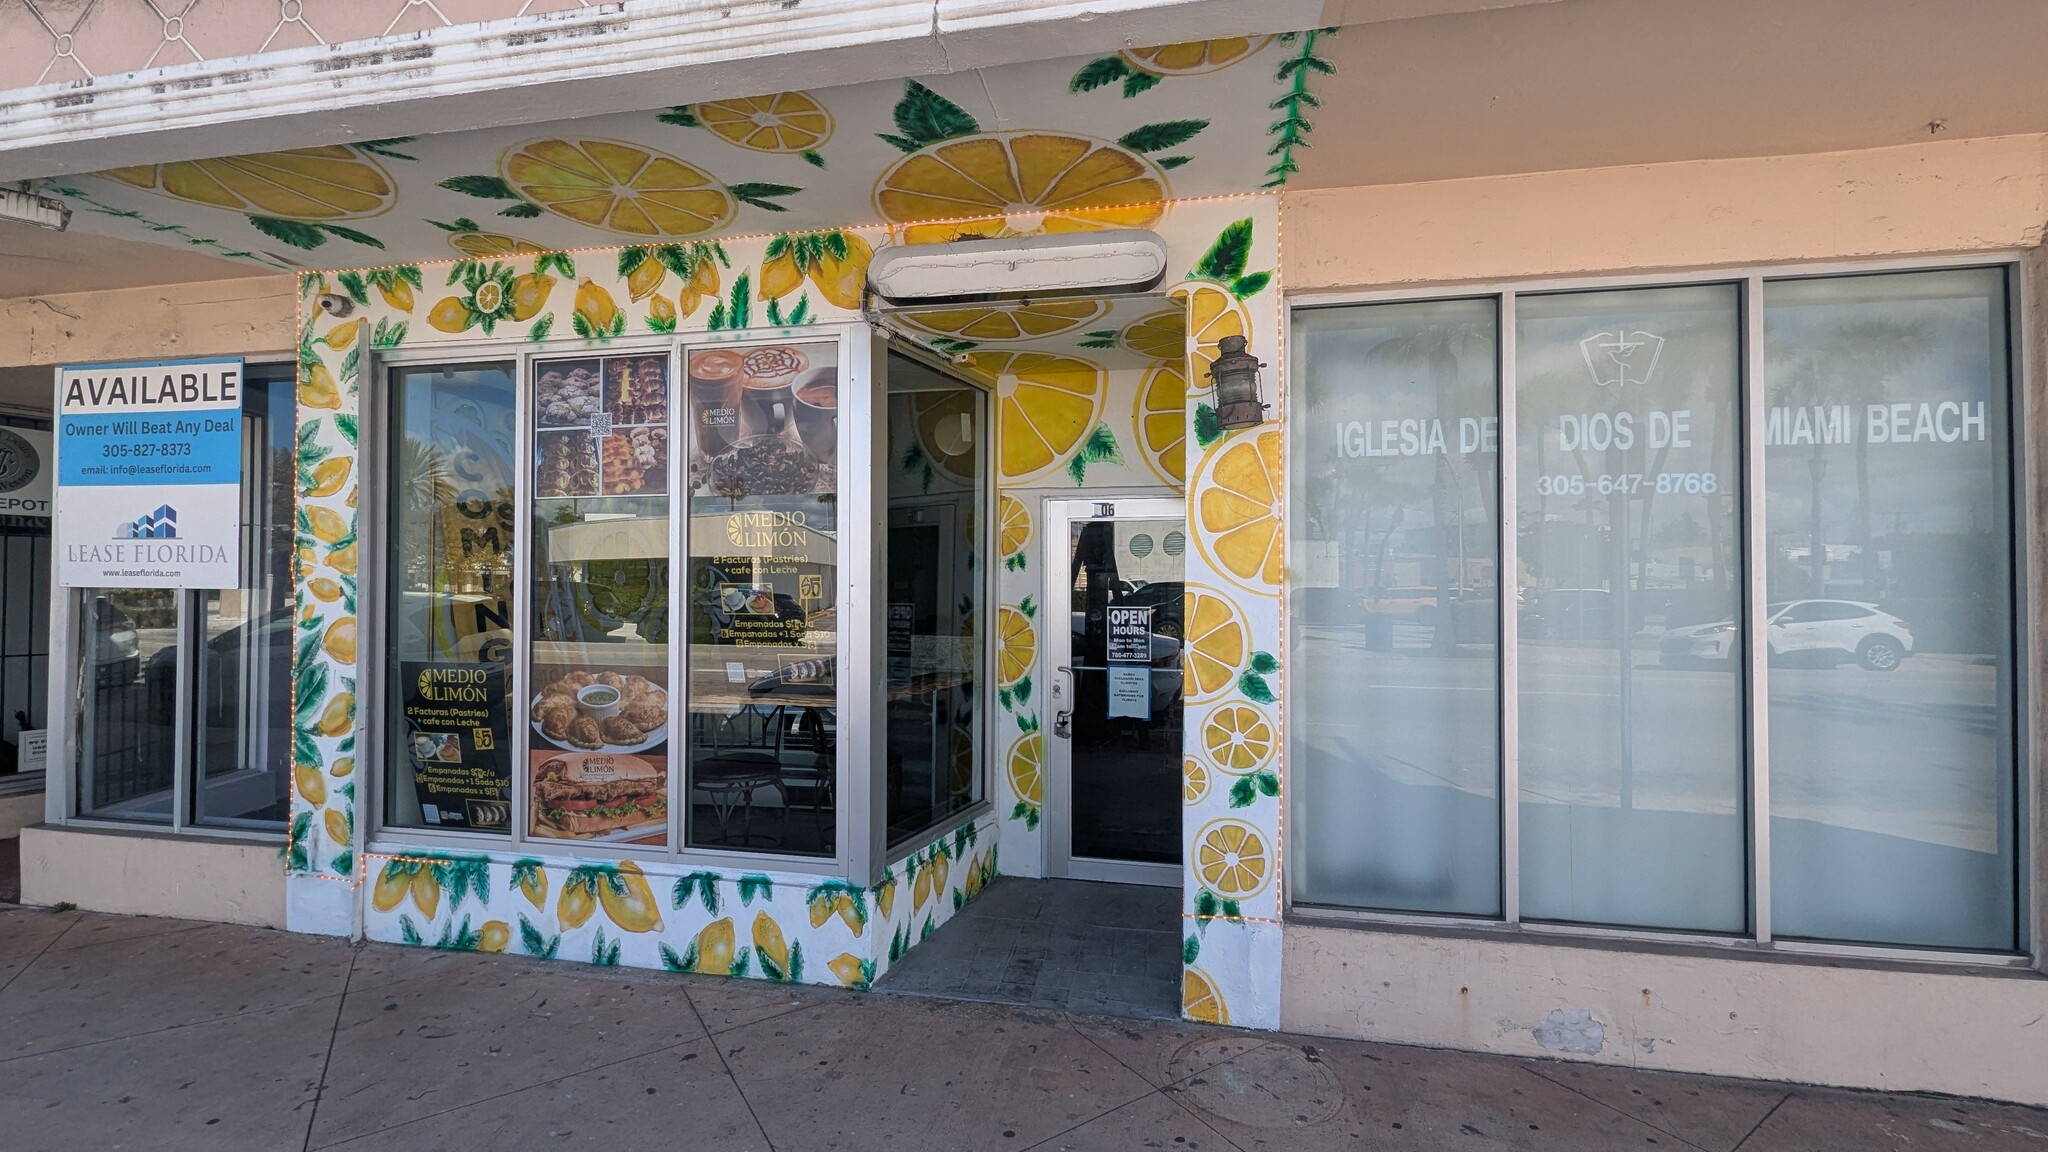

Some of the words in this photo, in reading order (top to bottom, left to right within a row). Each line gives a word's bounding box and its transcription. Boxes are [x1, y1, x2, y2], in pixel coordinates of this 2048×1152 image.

[65, 372, 237, 407] AVAILABLE
[709, 408, 735, 416] MEDIO
[709, 415, 735, 425] LIMÓN
[65, 423, 109, 436] Owner
[112, 421, 137, 435] Will
[141, 421, 172, 435] Beat
[175, 420, 201, 437] Any
[204, 418, 235, 433] Deal
[1336, 418, 1448, 458] IGLESIA
[1459, 416, 1498, 454] DE
[1559, 411, 1635, 451] DIOS
[1649, 410, 1692, 448] DE
[1764, 405, 1851, 446] MIAMI
[1867, 401, 1985, 444] BEACH
[102, 443, 191, 458] 305-827-8373
[81, 465, 109, 475] email:
[110, 464, 212, 476] info@leaseflorida.com
[1537, 472, 1718, 496] 305-647-8768
[744, 511, 806, 527] MEDIO
[745, 528, 807, 547] LIMÓN
[68, 544, 125, 563] LEASE
[135, 544, 229, 563] FLORIDA
[713, 556, 721, 564] 2
[721, 556, 761, 564] Facturas
[763, 554, 809, 564] (Pastries)
[102, 569, 181, 578] www.leaseflorida.com
[731, 566, 750, 574] cafe
[770, 565, 798, 574] Leche
[801, 576, 821, 598] $5
[1111, 610, 1148, 625] OPEN
[734, 620, 783, 629] Empanadas
[729, 630, 777, 639] Empanadas
[1113, 626, 1146, 635] HOURS
[744, 640, 793, 649] Empanadas
[433, 668, 487, 684] MEDIO
[434, 684, 487, 702] LIMÓN
[407, 707, 413, 715] 2
[414, 707, 449, 716] Facturas
[450, 707, 489, 718] (Pastries)
[423, 718, 440, 726] cafe
[456, 718, 480, 727] Leche
[475, 730, 492, 748] $5
[590, 757, 615, 765] MEDIO
[427, 766, 469, 776] Empanadas
[590, 765, 615, 773] LIMÓN
[424, 775, 465, 784] Empanadas
[475, 778, 494, 786] Soda
[495, 779, 510, 787] $10
[437, 785, 478, 794] Empanadas
